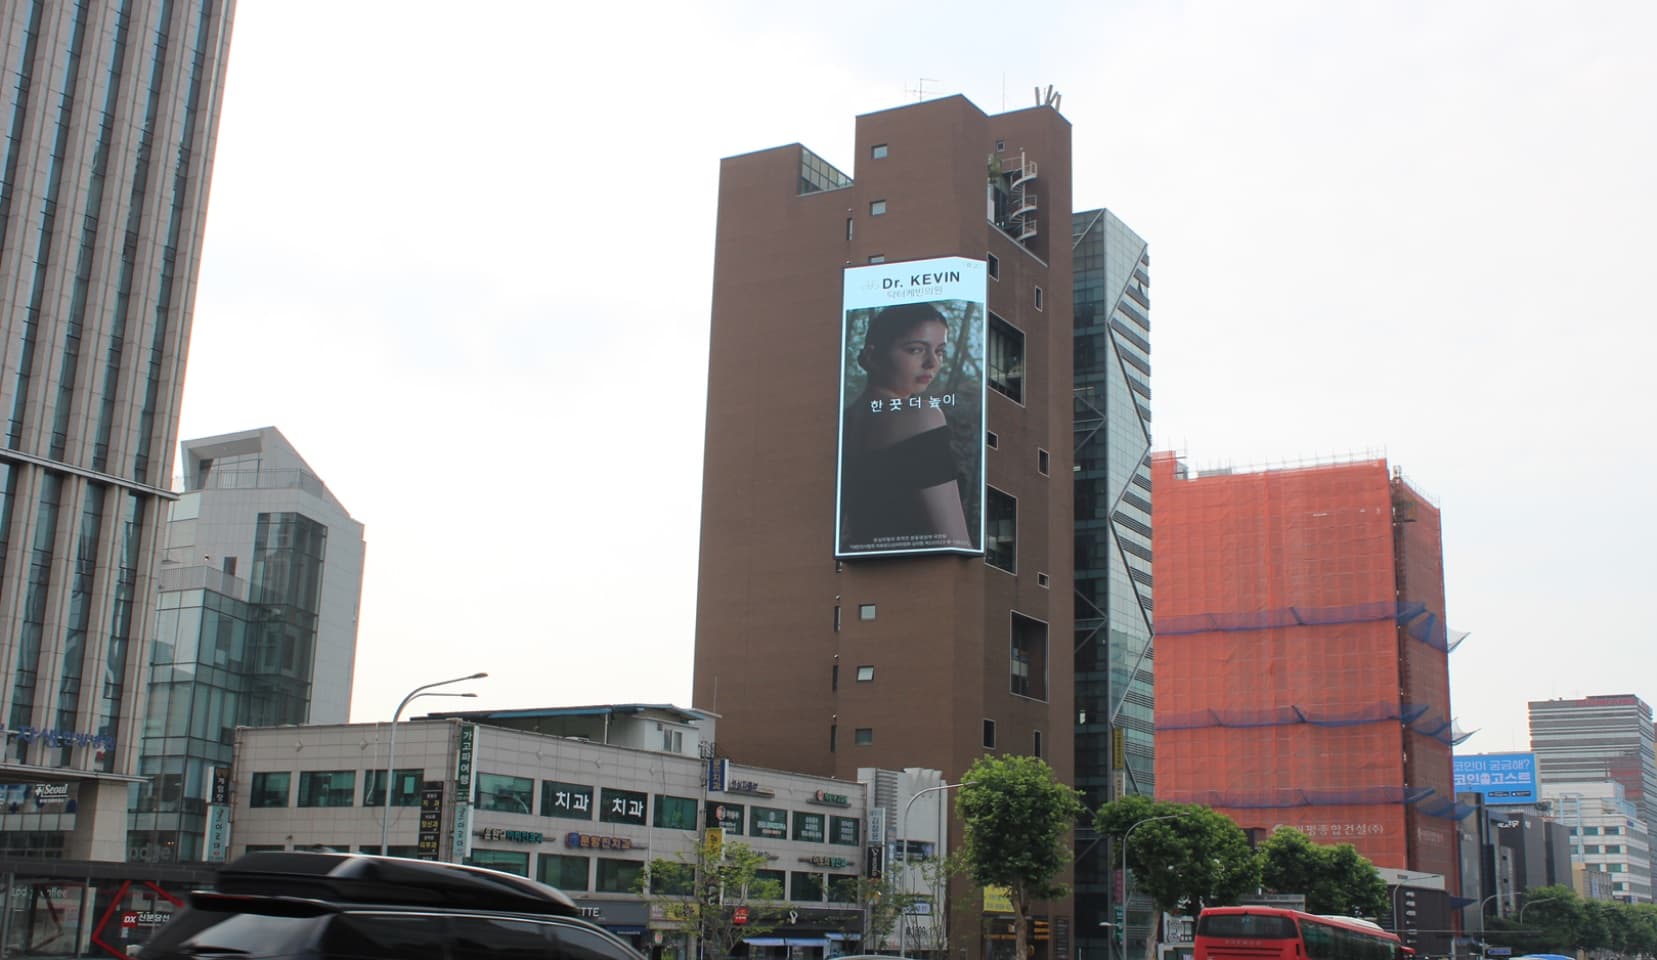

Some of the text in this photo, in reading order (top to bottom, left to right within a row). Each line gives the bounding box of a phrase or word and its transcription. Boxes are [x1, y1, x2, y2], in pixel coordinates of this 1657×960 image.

[882, 271, 960, 290] Dr. KEVIN
[870, 399, 882, 413] 한
[909, 396, 921, 409] 더
[928, 393, 955, 408] 높이
[555, 791, 590, 812] 치과
[612, 798, 644, 818] 치과
[123, 915, 137, 923] DX
